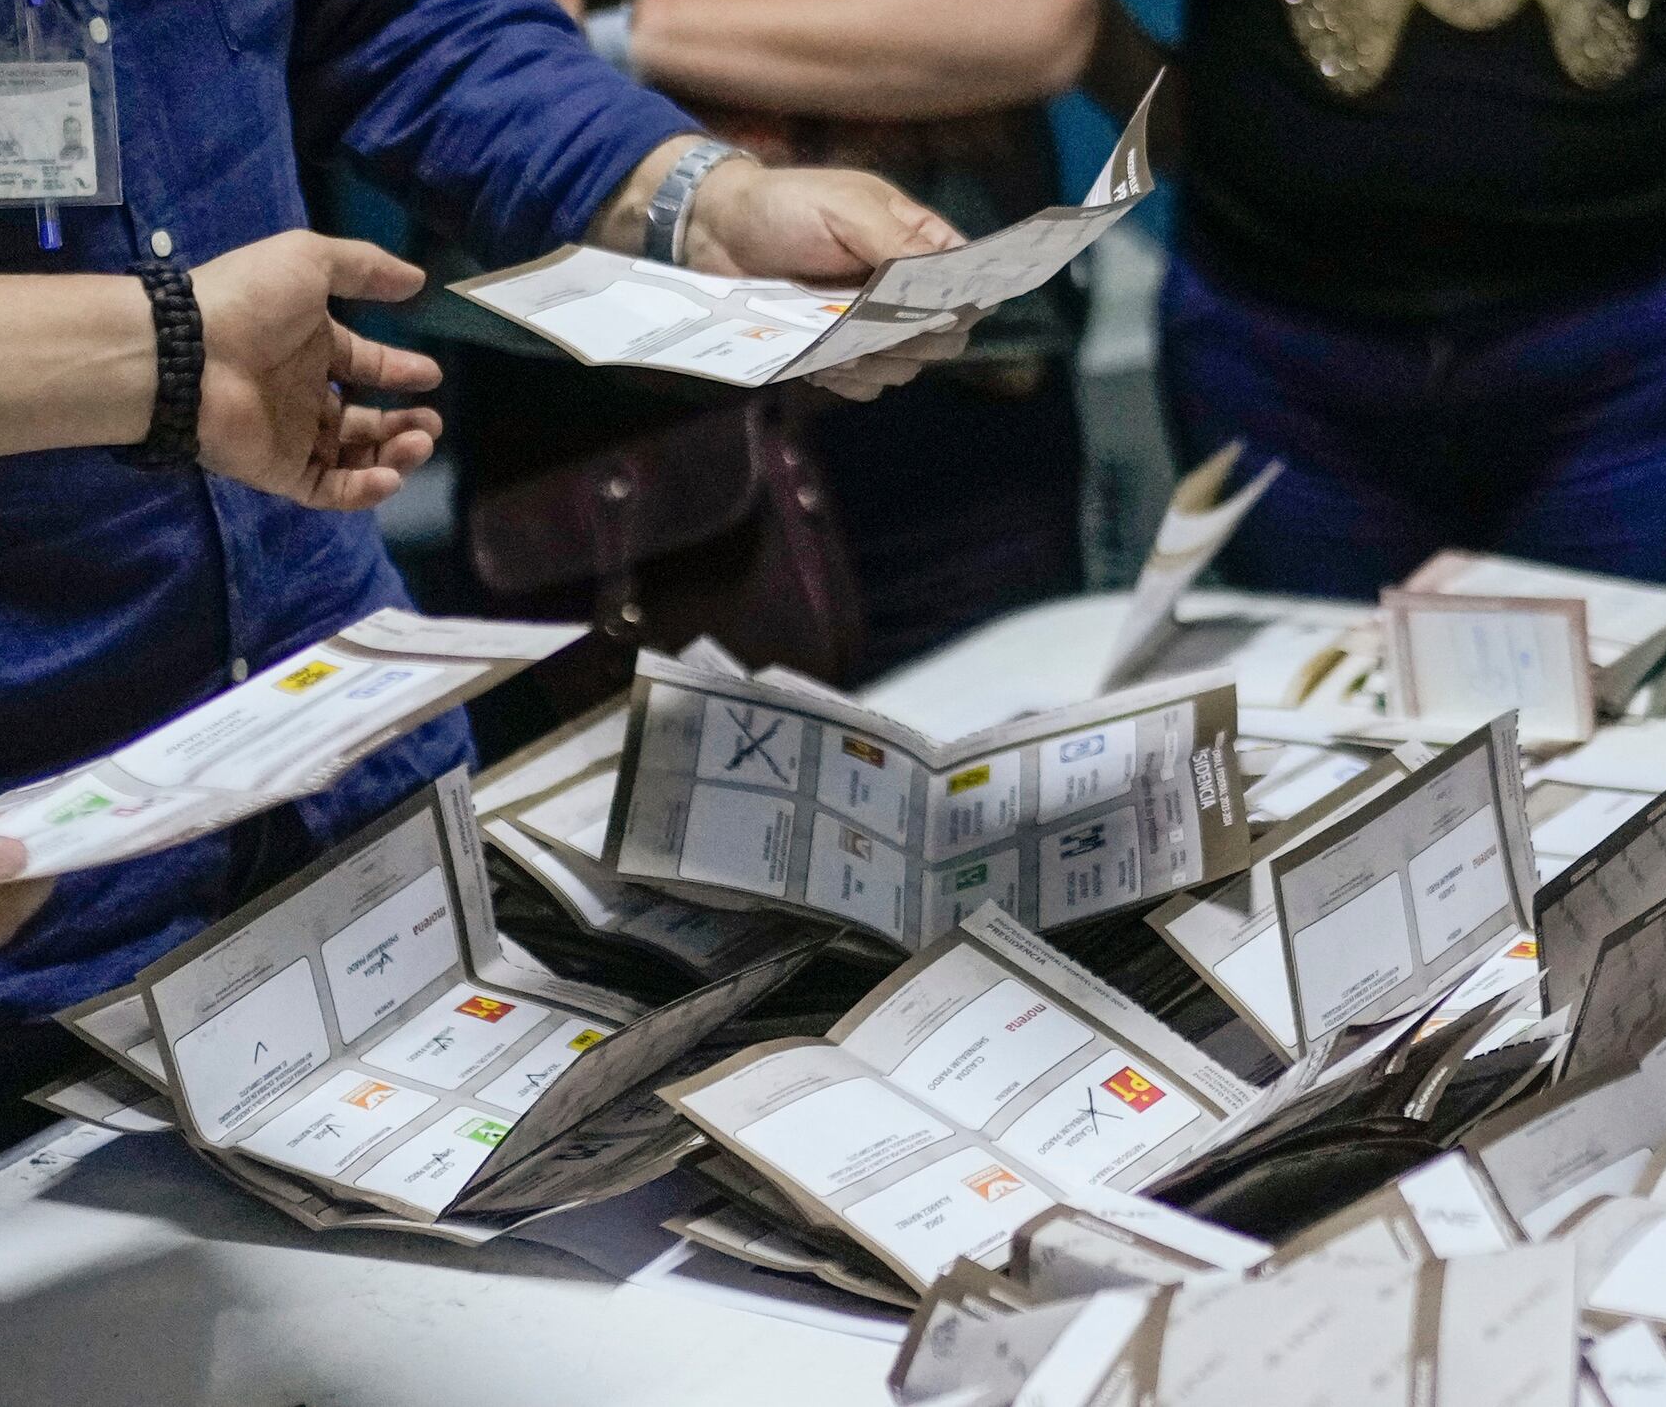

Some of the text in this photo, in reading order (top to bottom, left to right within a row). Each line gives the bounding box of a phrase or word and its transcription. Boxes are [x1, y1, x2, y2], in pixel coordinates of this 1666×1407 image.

[412, 906, 447, 936] morena
[984, 919, 1046, 968] PRESIDENCIA
[1005, 1001, 1049, 1033] morena
[924, 1033, 990, 1092] SHEINBAUM PARDO
[952, 1053, 986, 1083] CLAUDIA
[1109, 1068, 1152, 1104] PT
[1036, 1131, 1063, 1156] PARDO
[1063, 1123, 1093, 1150] CLAUDIA
